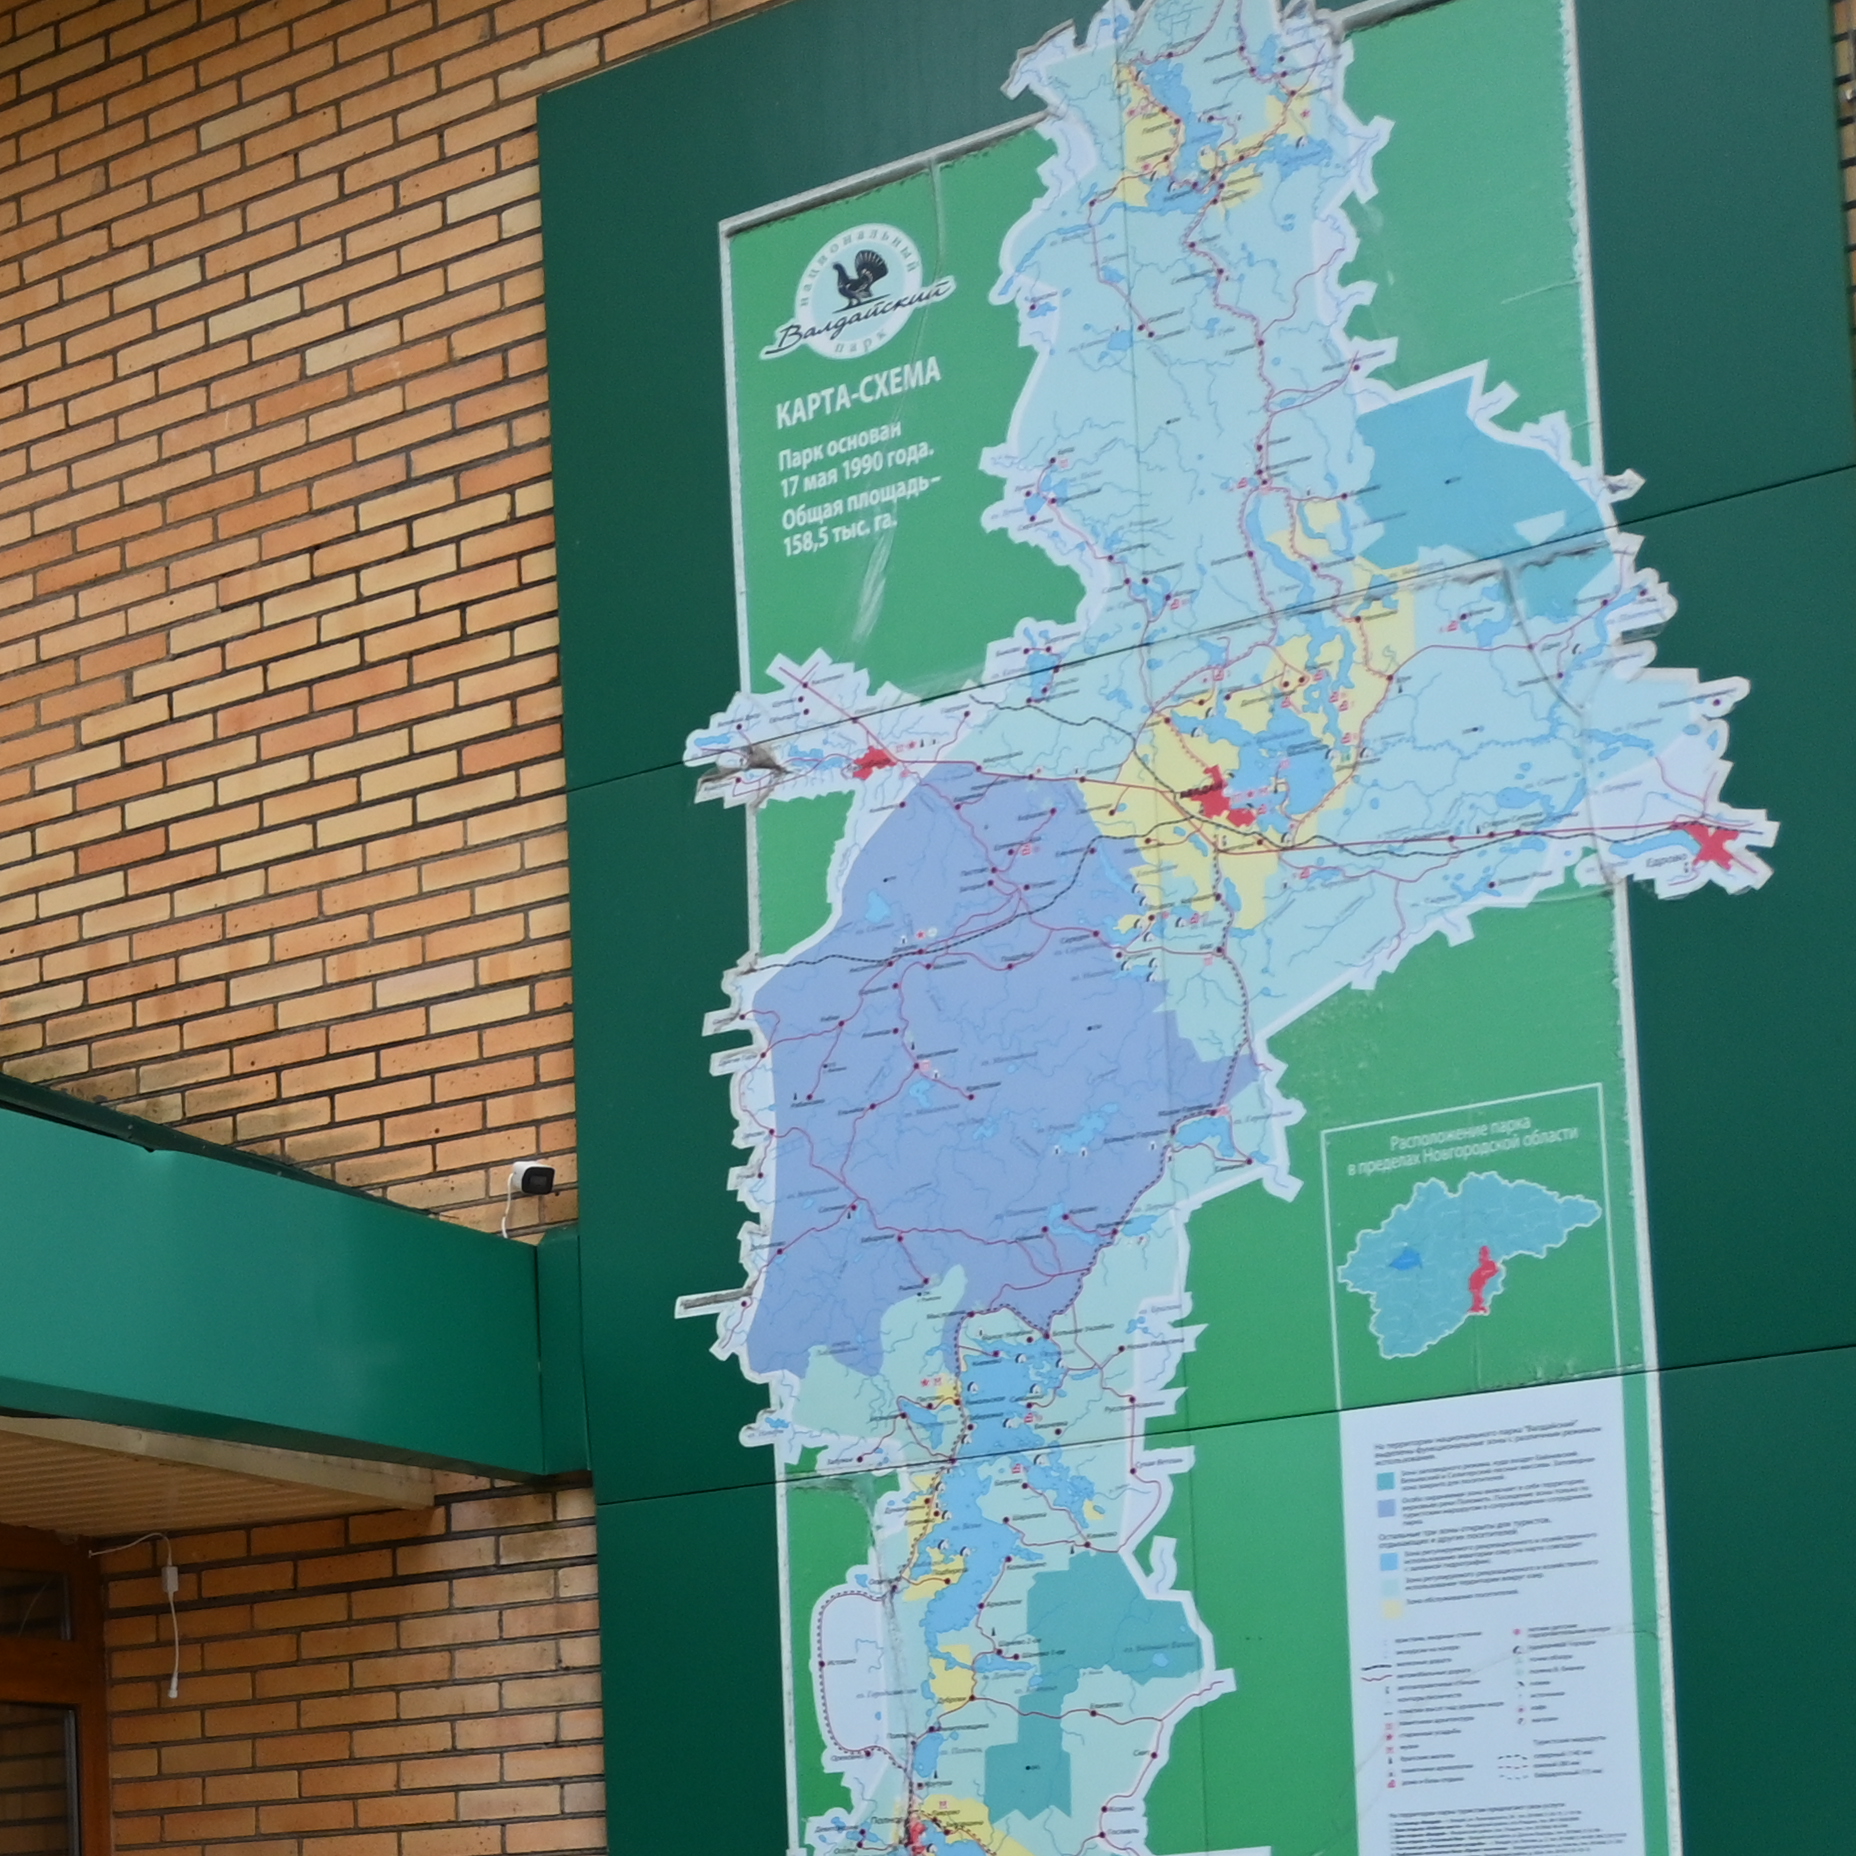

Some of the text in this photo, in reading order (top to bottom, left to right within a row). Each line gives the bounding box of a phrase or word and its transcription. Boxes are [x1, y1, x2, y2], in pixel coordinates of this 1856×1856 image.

[764, 280, 951, 355] Валдайский
[834, 329, 887, 354] парк
[776, 356, 941, 429] КАРТА-СХЕМА
[779, 421, 902, 471] Парк основан
[781, 441, 934, 498] 17 мая 1990 года.
[782, 499, 843, 529] Общая
[783, 512, 898, 557] 158,5 тыс. га.
[1358, 1152, 1420, 1176] пределах
[1422, 1133, 1520, 1163] Новгородской
[1522, 1127, 1579, 1148] области
[1389, 1116, 1531, 1151] Расположение парка
